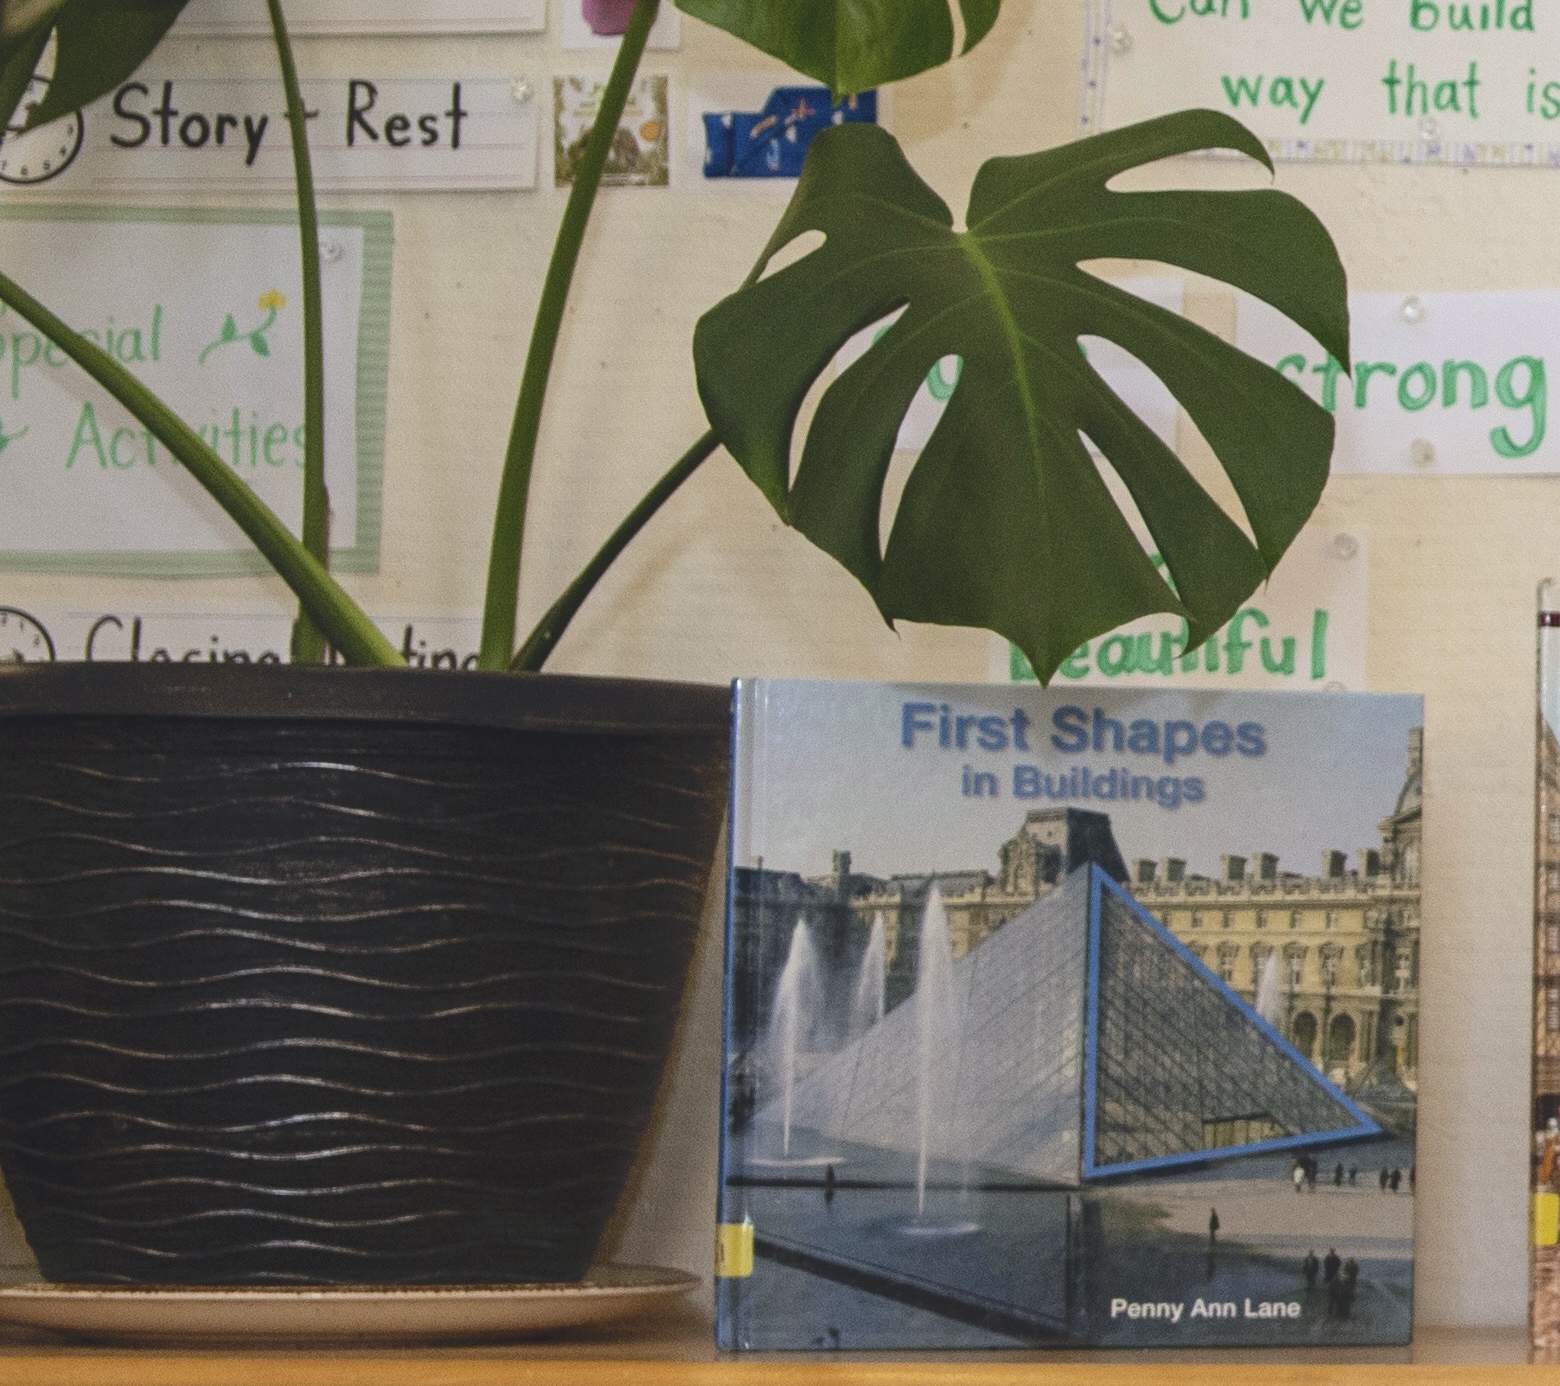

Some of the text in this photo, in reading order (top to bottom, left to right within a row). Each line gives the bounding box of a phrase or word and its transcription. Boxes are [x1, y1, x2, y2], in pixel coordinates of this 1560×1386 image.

[110, 81, 268, 166] Story
[347, 79, 468, 149] Rest
[1220, 72, 1324, 125] way
[1381, 59, 1482, 118] that
[0, 303, 163, 401] peial
[65, 401, 305, 470] Actities
[900, 701, 1268, 764] First Shapes
[961, 763, 1206, 810] in Buildings
[1110, 1298, 1301, 1324] Penny Ann Lane
